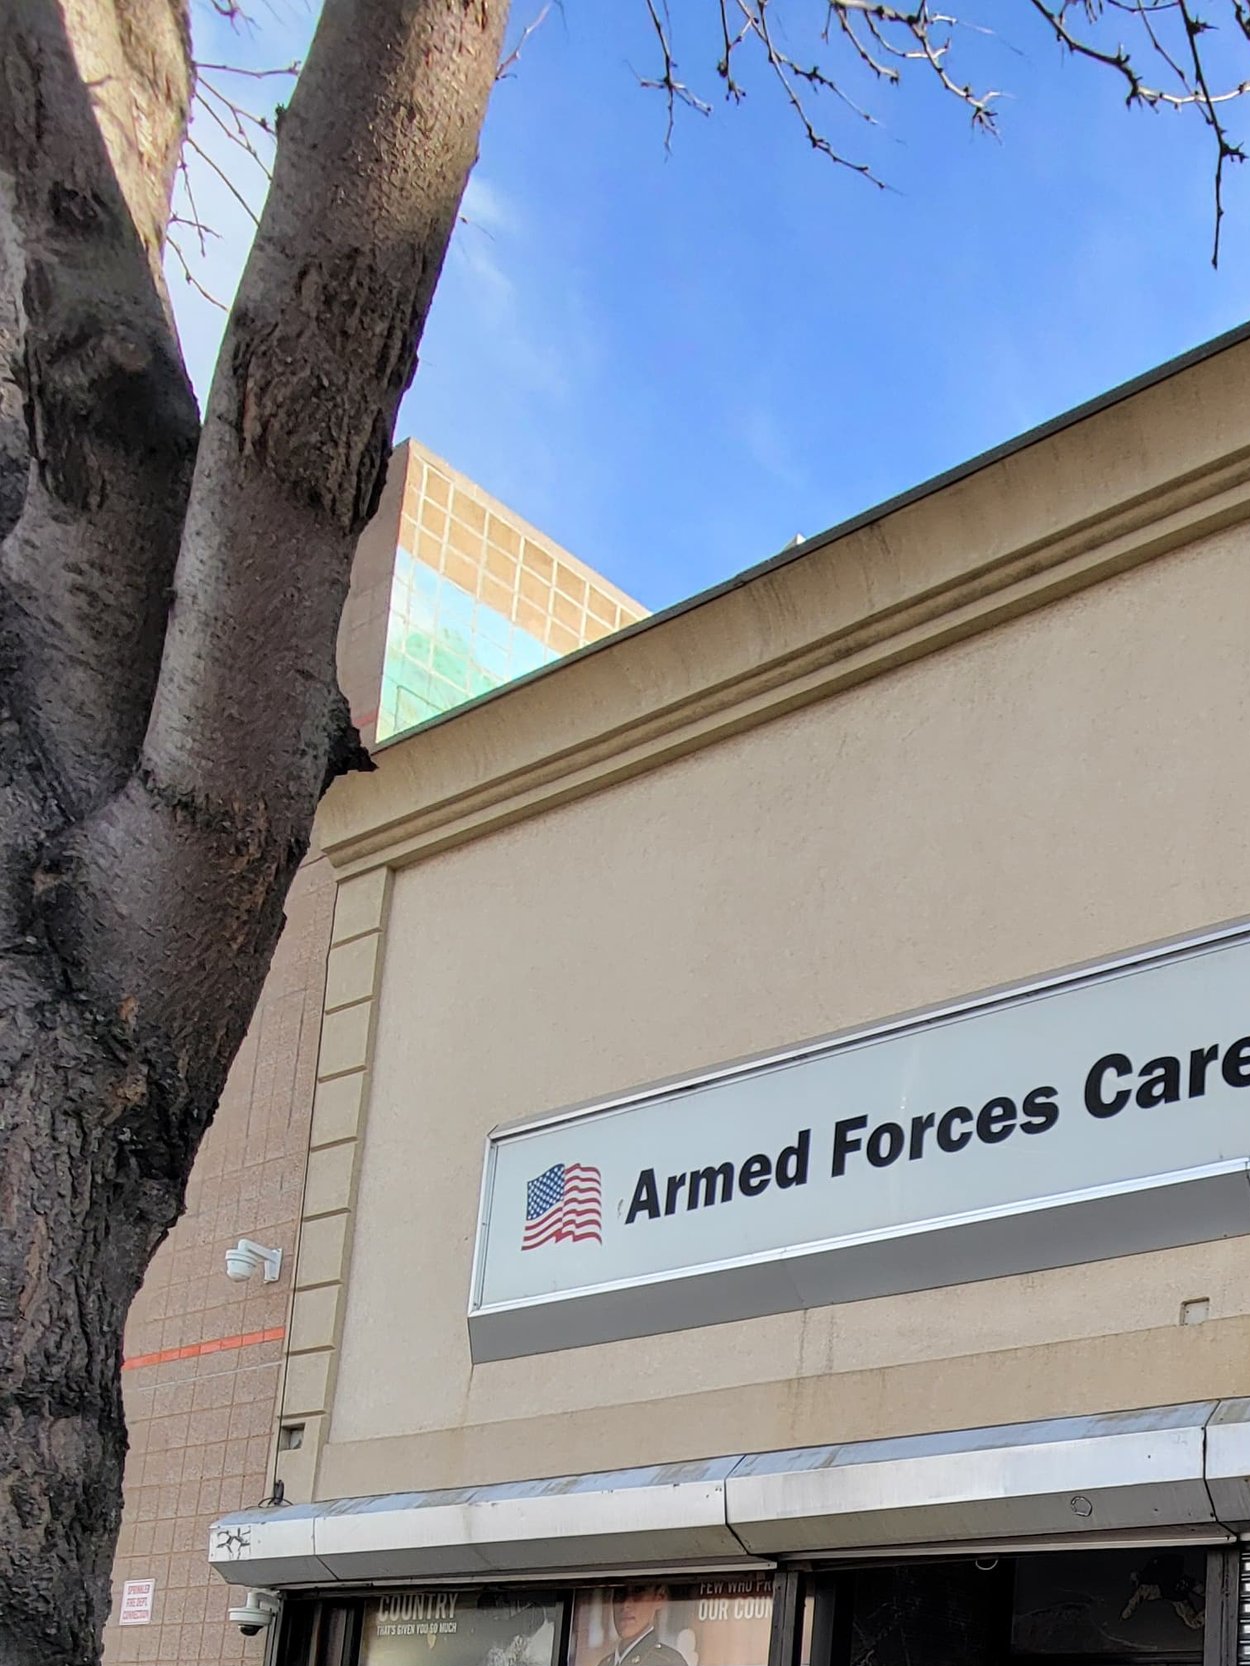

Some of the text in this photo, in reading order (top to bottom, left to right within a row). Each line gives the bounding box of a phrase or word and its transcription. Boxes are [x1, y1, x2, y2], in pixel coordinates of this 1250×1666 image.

[624, 1127, 812, 1226] Armed
[830, 1085, 1060, 1179] Forces
[700, 1580, 724, 1595] FEW
[728, 1579, 753, 1593] WHO
[379, 1592, 459, 1622] COUNTRY
[698, 1599, 729, 1621] OUR
[376, 1622, 457, 1636] THAT'S GIVEN YOU SO MUCH
